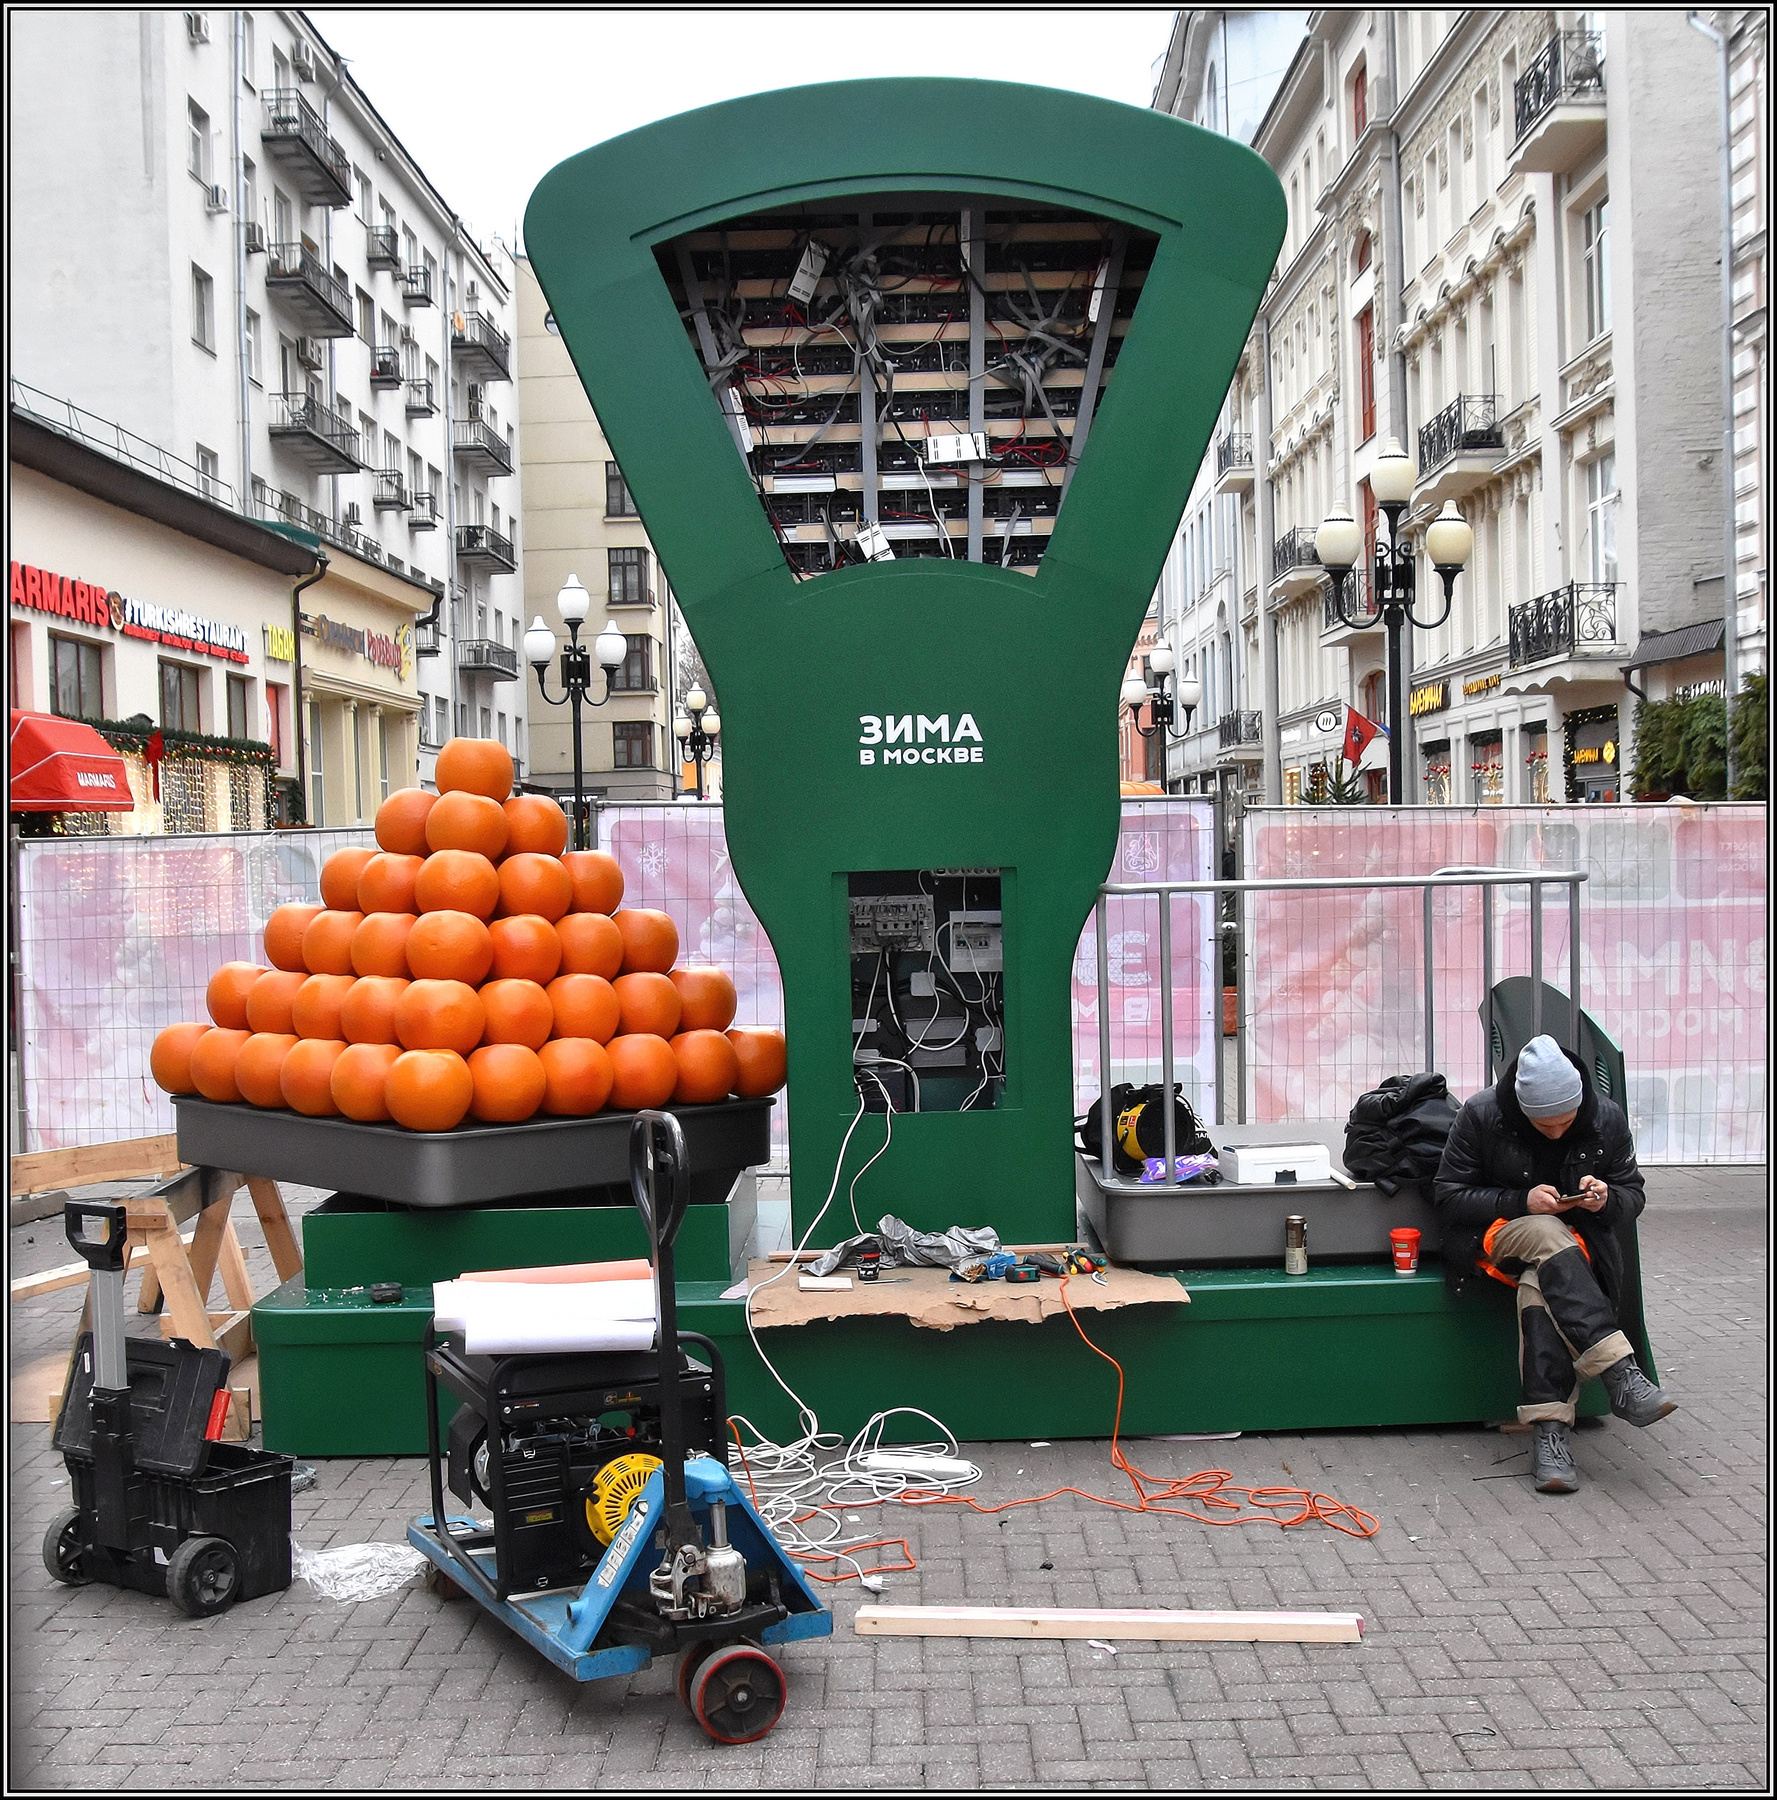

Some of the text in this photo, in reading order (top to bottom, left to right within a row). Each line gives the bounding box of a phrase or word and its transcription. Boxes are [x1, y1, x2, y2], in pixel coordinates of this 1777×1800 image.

[859, 713, 984, 745] ЗИМА
[859, 747, 984, 765] В МОСКВЕ
[76, 771, 117, 789] MARMARIS
